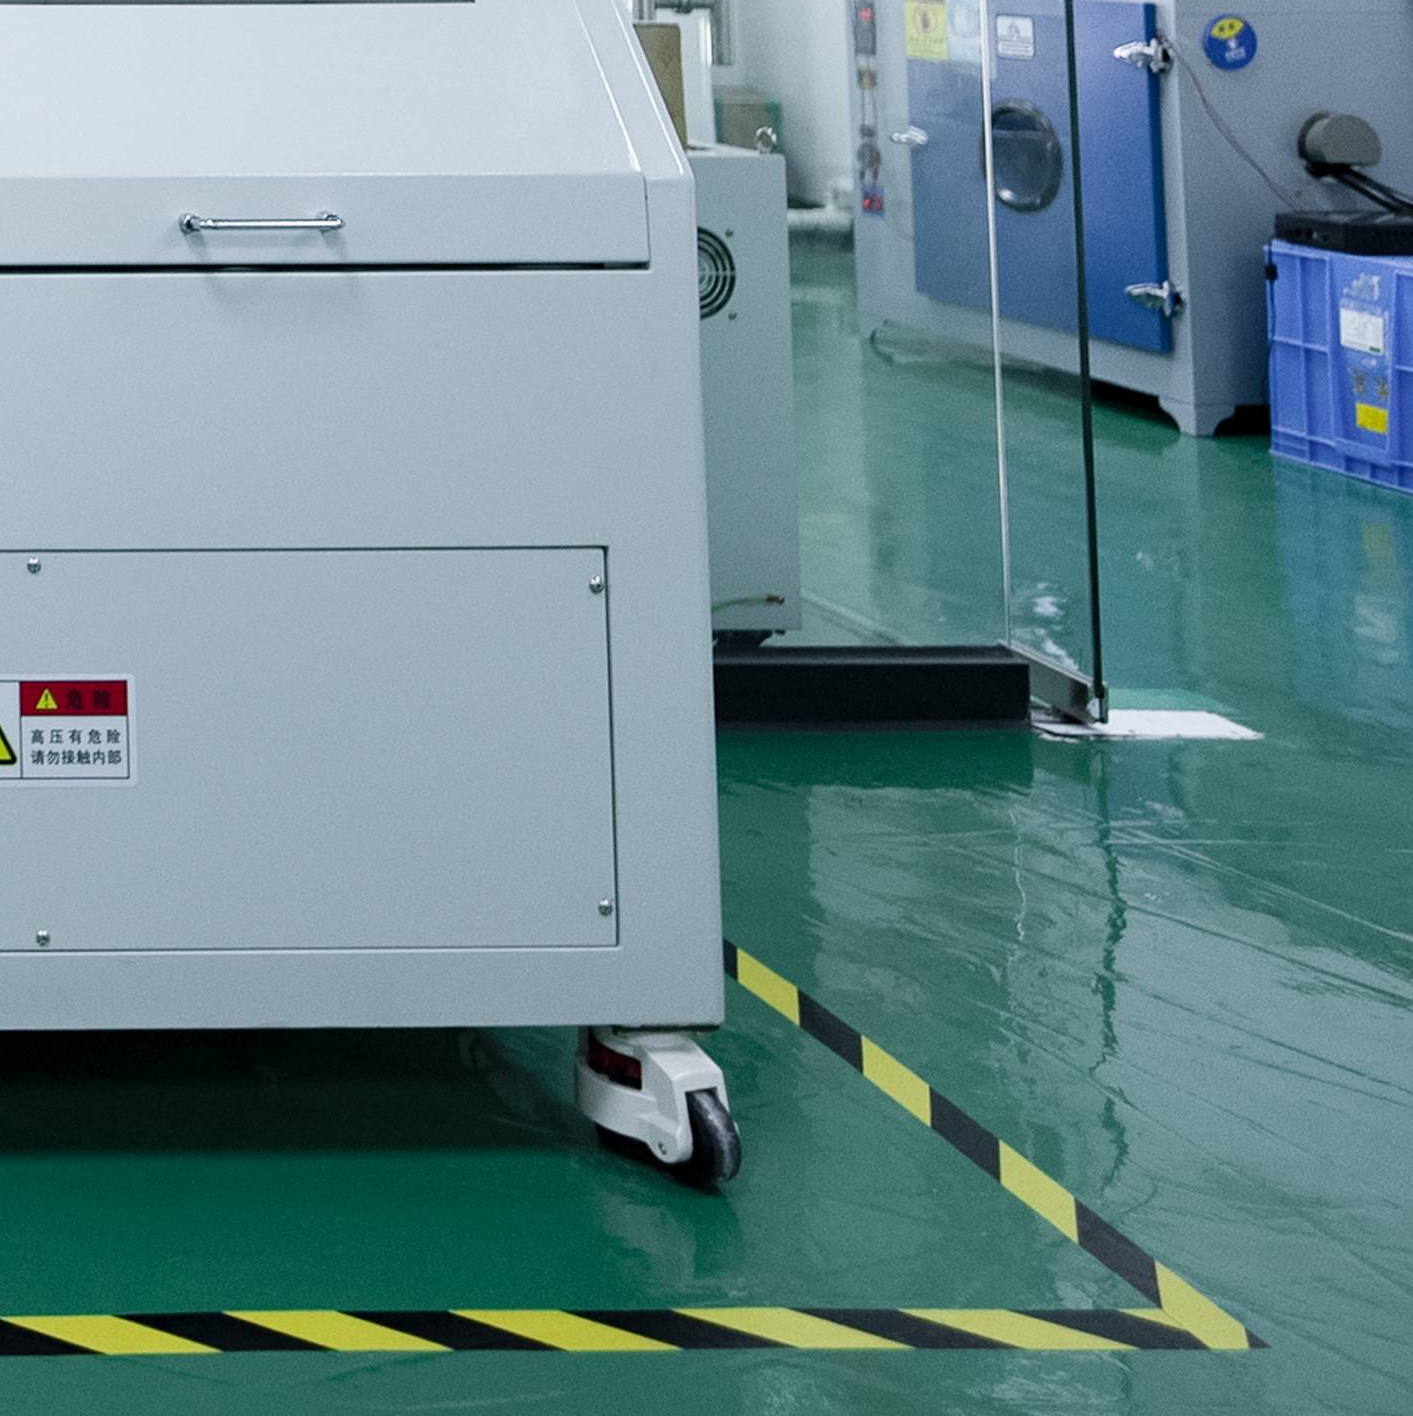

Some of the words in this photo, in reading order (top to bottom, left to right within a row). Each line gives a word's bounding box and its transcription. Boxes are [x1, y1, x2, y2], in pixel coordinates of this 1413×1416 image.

[65, 689, 111, 709] 危险
[30, 729, 121, 744] 高压有危险
[30, 749, 122, 765] 请勿接触内部
